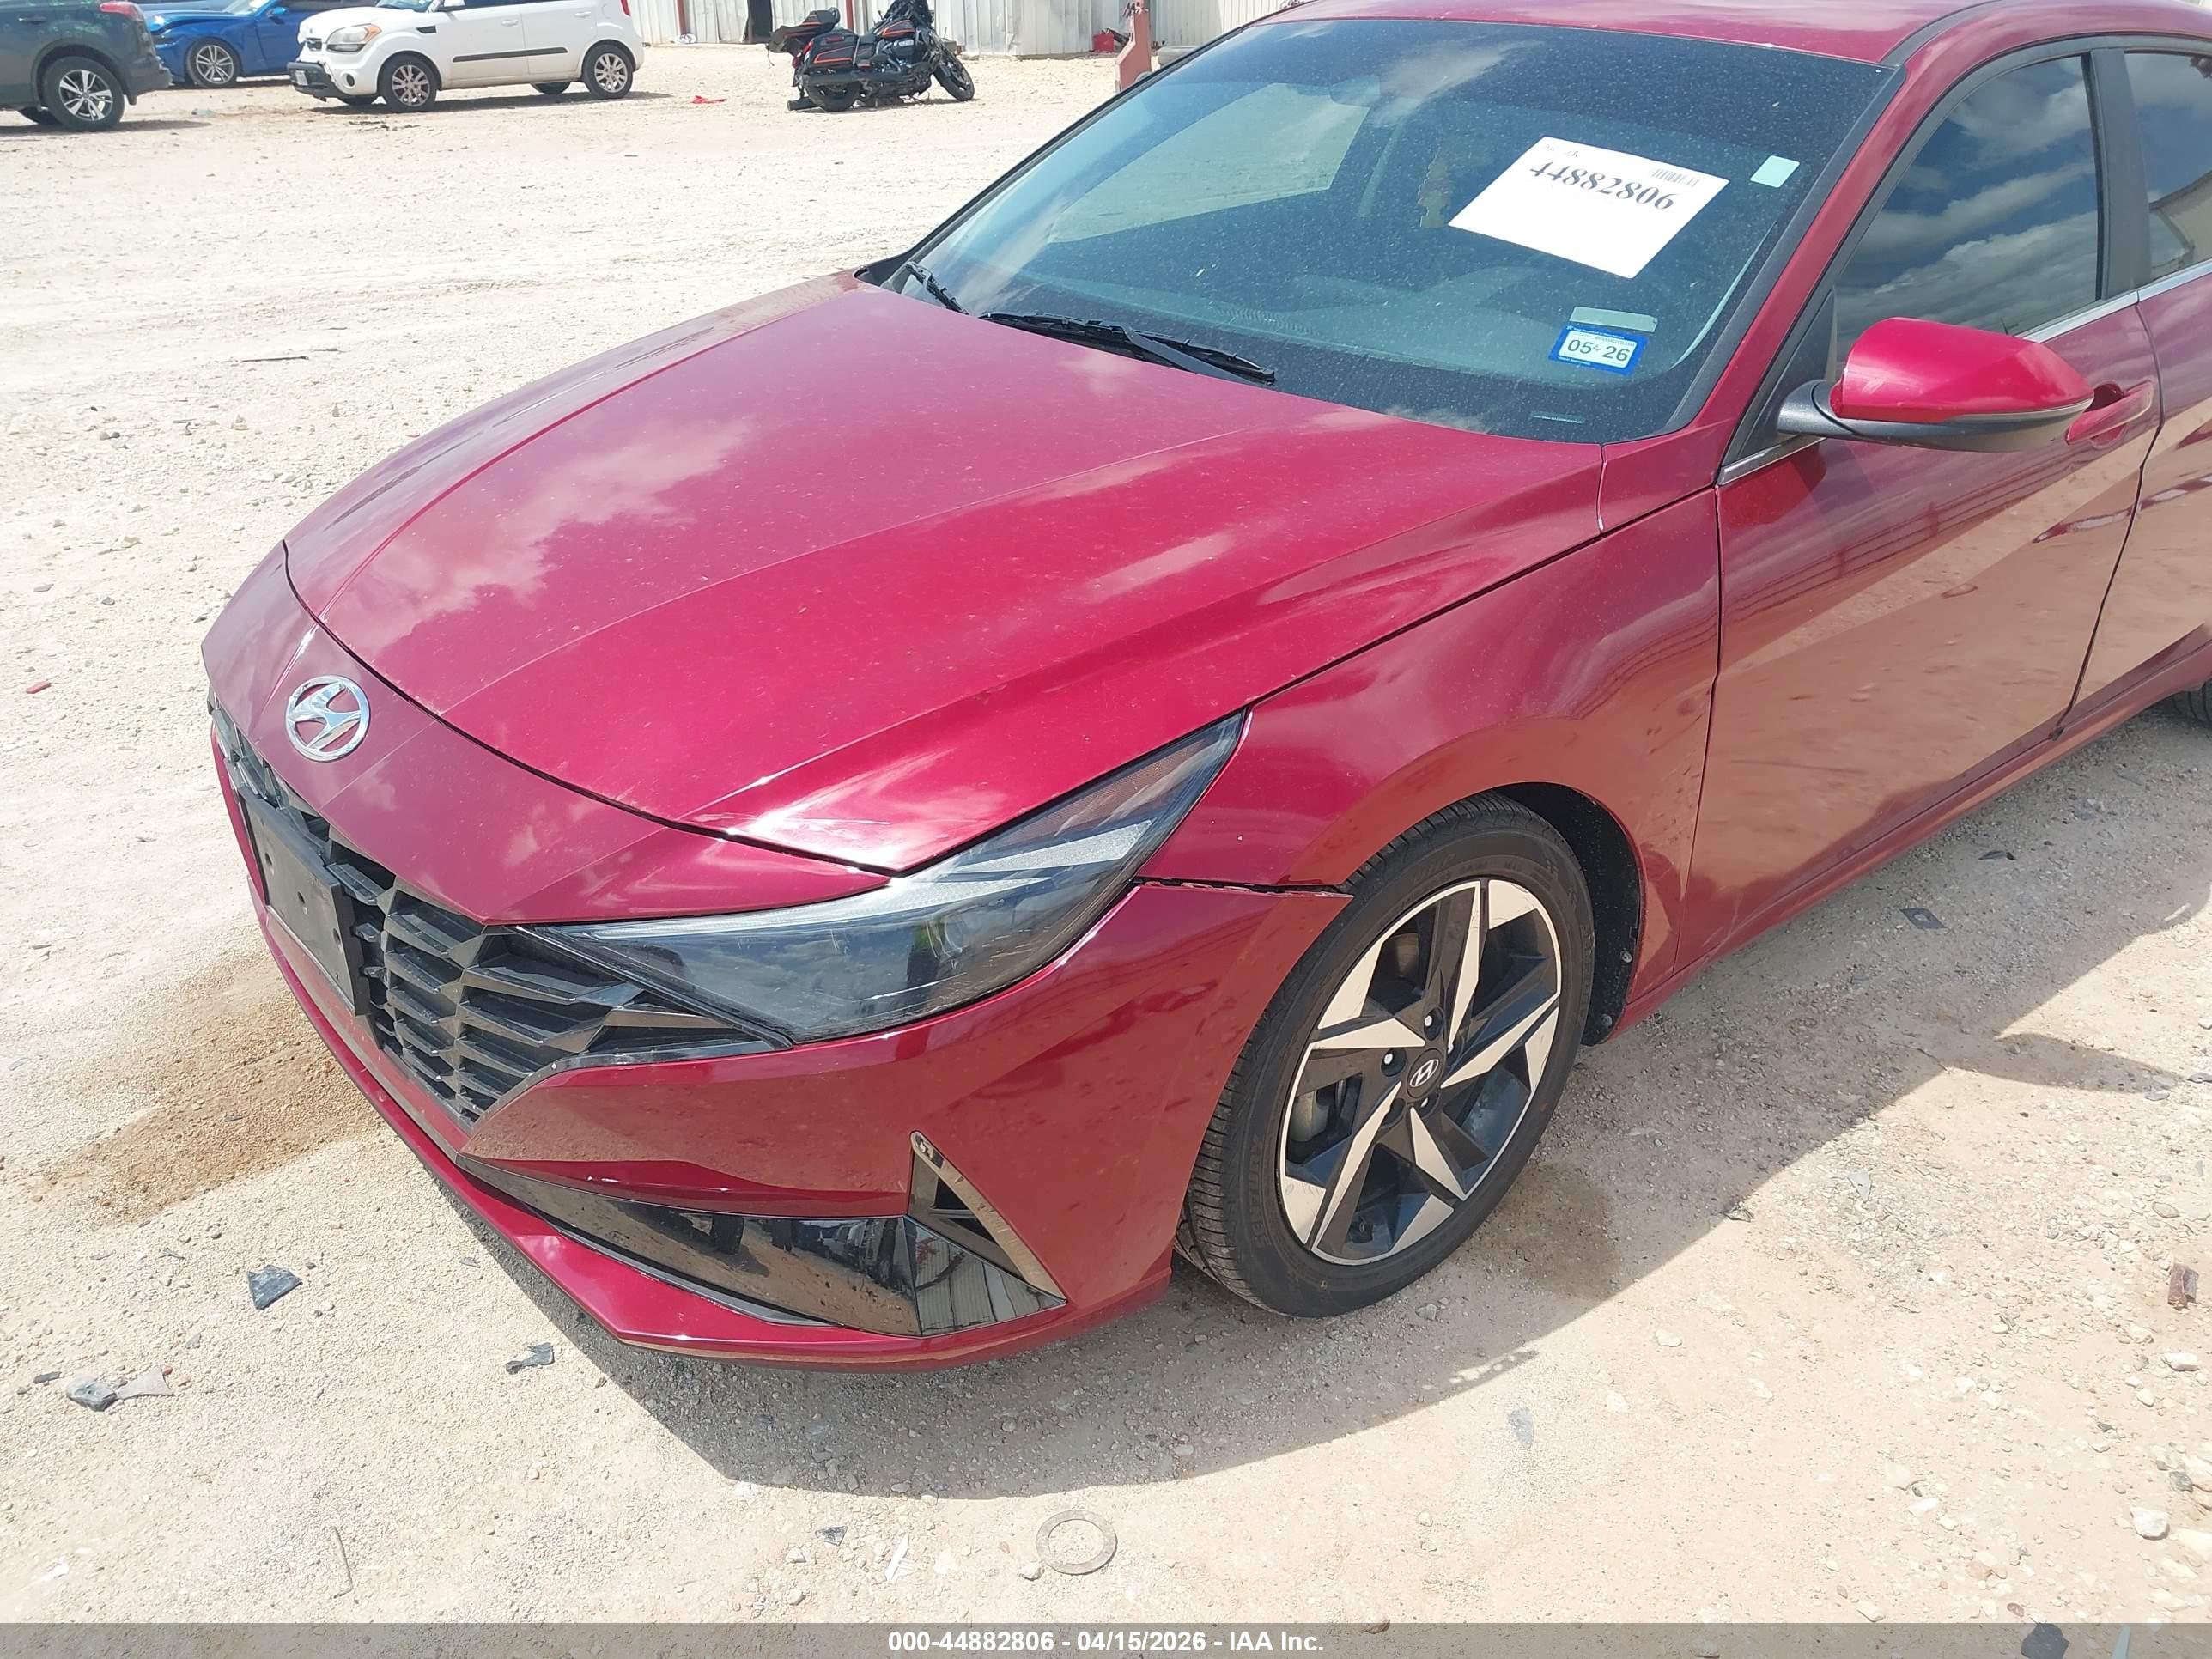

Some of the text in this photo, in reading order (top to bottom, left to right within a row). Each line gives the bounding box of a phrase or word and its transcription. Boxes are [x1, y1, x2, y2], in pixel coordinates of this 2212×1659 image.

[1529, 161, 1680, 210] 44882806
[1567, 339, 1594, 355] 05
[1601, 345, 1631, 362] 26
